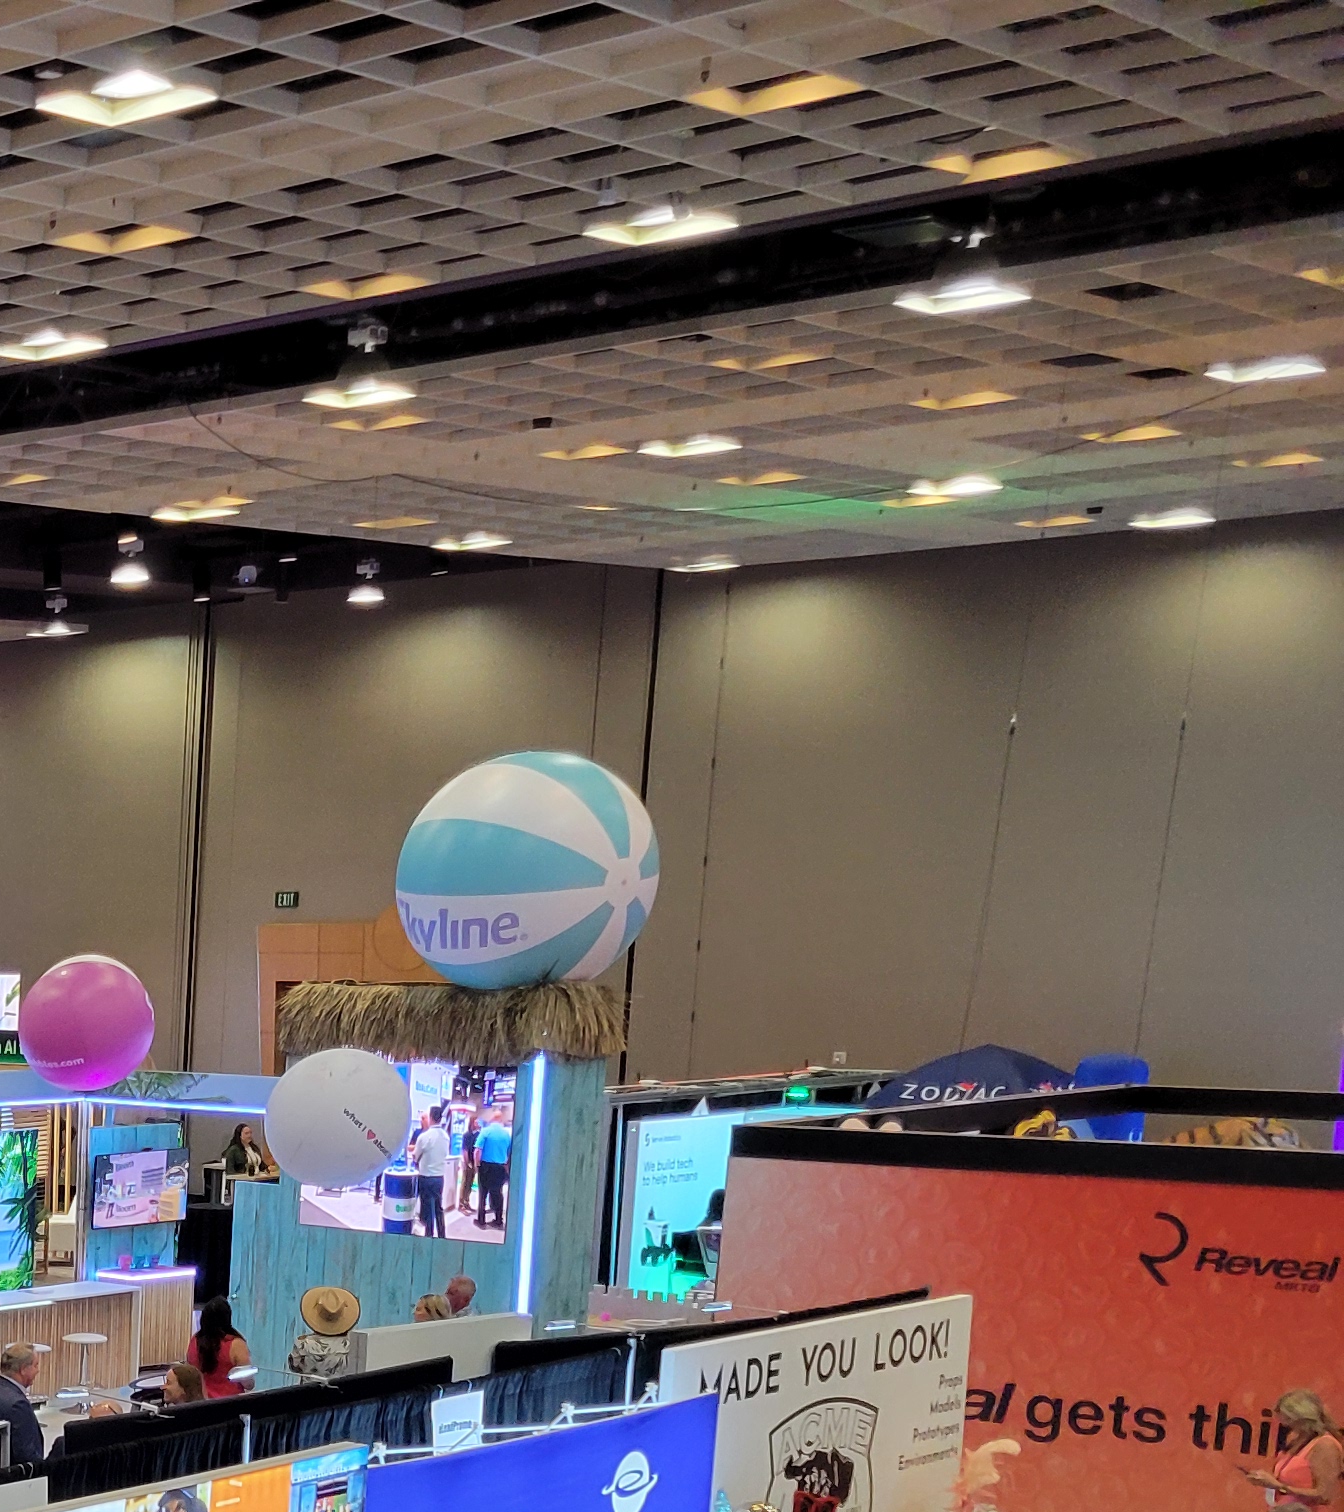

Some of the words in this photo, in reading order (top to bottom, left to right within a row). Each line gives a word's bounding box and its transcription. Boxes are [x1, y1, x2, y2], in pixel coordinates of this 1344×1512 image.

[278, 893, 295, 907] EXIT
[899, 1083, 1006, 1104] ZODIAC
[343, 1108, 363, 1129] what
[644, 1161, 656, 1172] We
[657, 1159, 675, 1171] build
[677, 1158, 693, 1170] tech
[653, 1174, 668, 1186] help
[669, 1172, 698, 1183] humans
[1194, 1247, 1341, 1283] Reveal
[699, 1352, 783, 1405] MADE
[801, 1336, 857, 1387] YOU
[873, 1318, 951, 1373] LOOK!
[939, 1374, 963, 1390] Props
[930, 1393, 961, 1415] Models
[1024, 1395, 1166, 1443] gets
[776, 1407, 874, 1476] ACME
[912, 1423, 960, 1443] Prototypes
